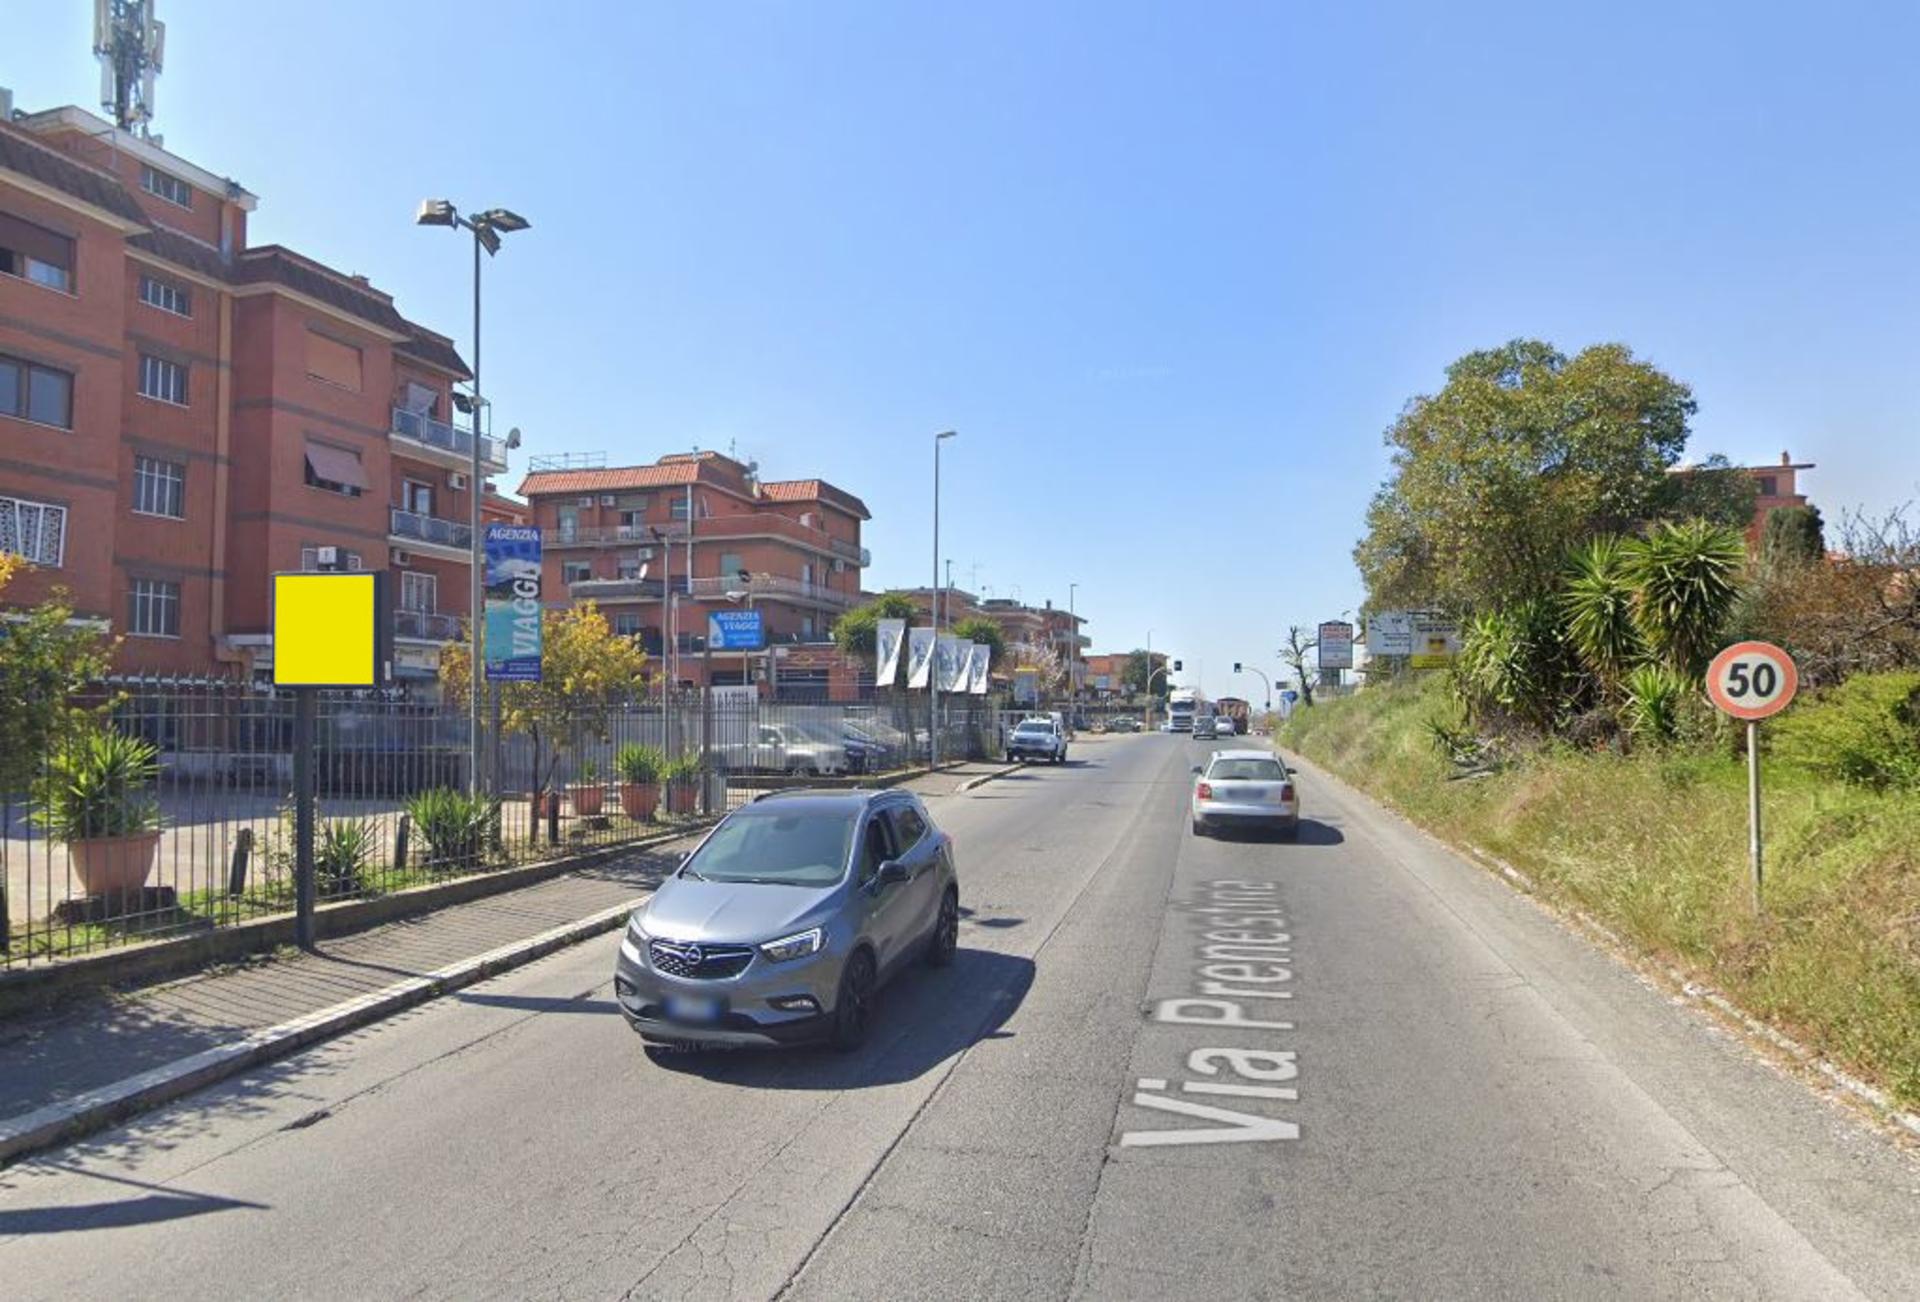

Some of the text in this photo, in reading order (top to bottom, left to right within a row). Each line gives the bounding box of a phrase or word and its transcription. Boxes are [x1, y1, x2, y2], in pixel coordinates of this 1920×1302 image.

[488, 527, 539, 542] AGENZIA
[512, 567, 540, 656] VIAGGI
[1726, 662, 1776, 698] 50
